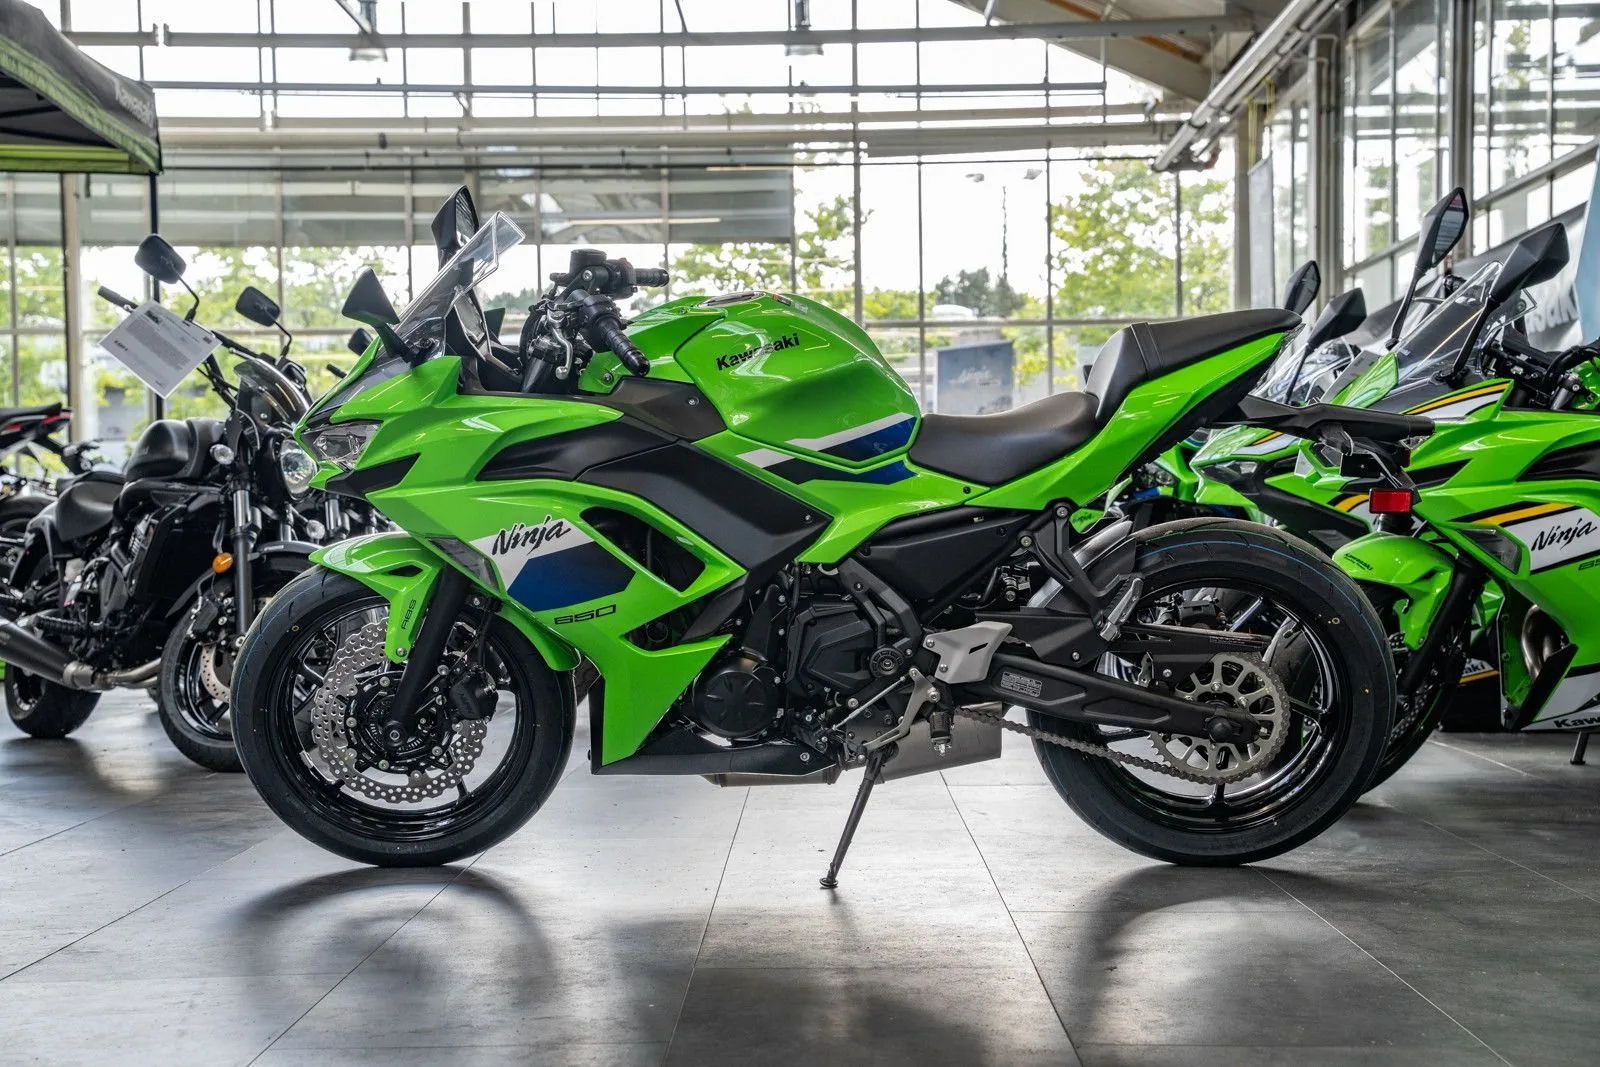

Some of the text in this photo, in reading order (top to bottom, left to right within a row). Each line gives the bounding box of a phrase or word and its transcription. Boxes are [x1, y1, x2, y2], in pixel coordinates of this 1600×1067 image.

[716, 333, 800, 371] Kawasaki
[491, 515, 571, 556] Ninja
[1530, 517, 1598, 551] Ninja
[401, 599, 417, 630] ABS
[554, 604, 617, 625] 650
